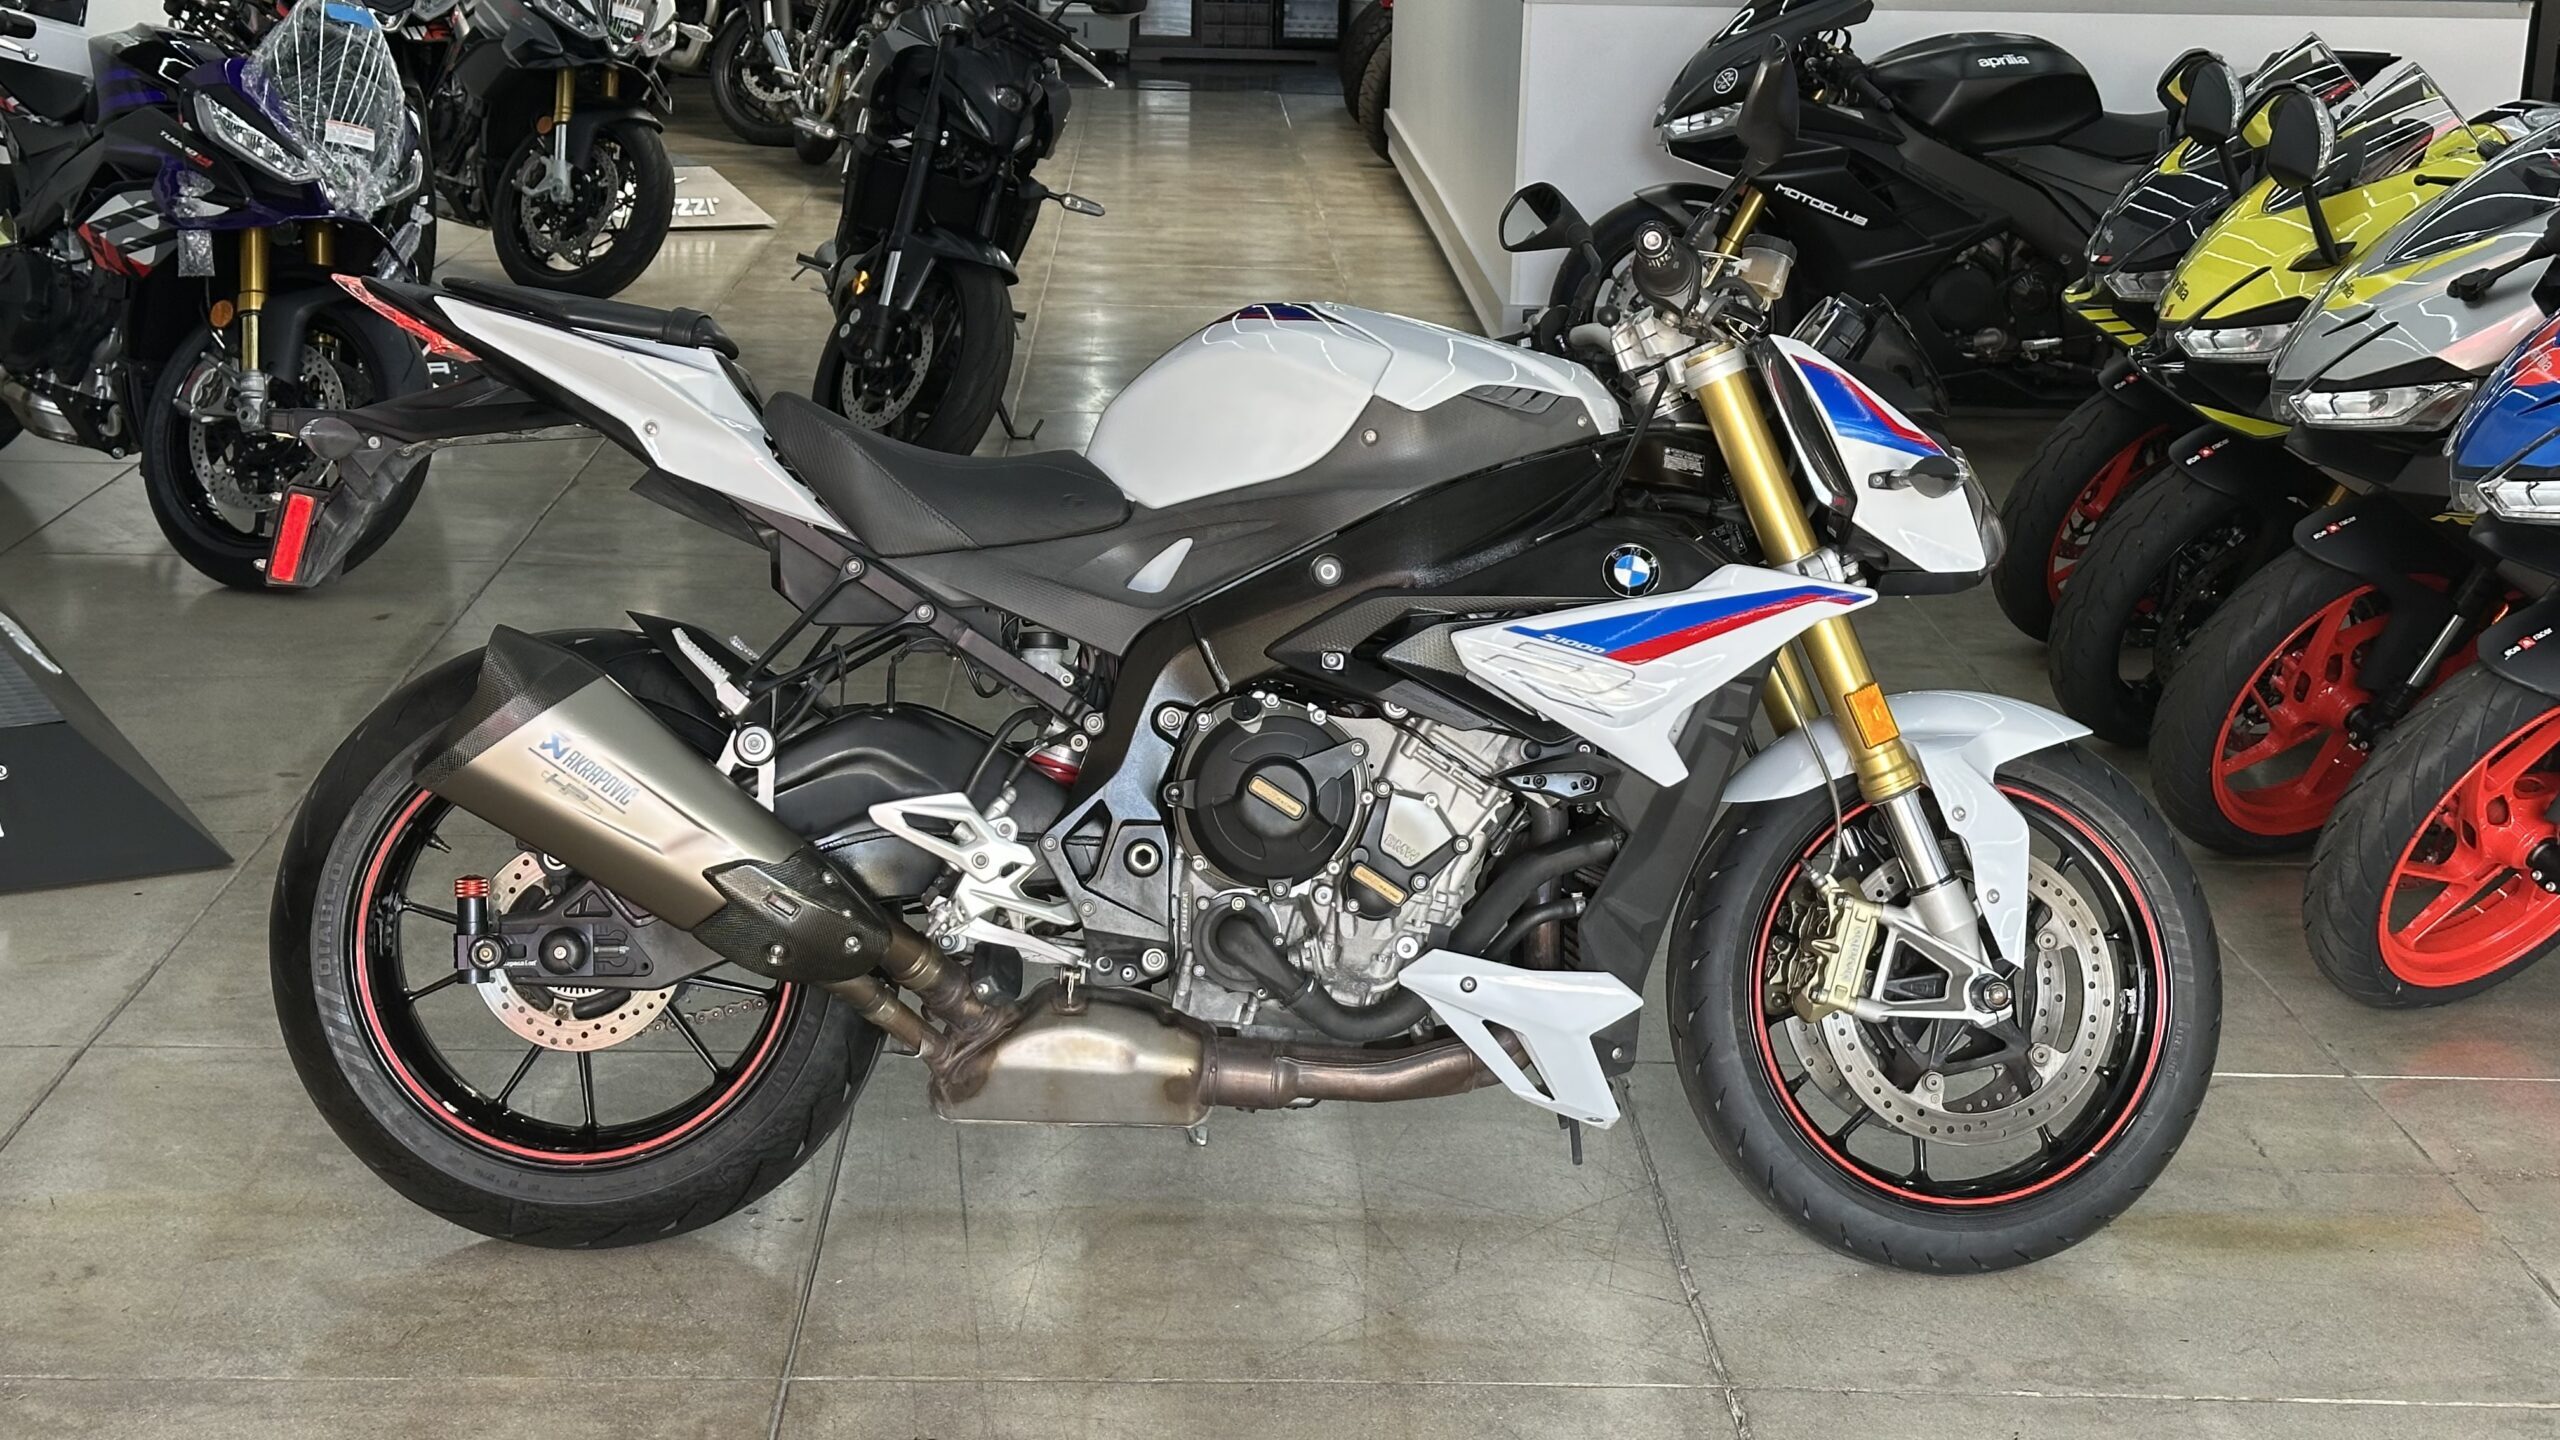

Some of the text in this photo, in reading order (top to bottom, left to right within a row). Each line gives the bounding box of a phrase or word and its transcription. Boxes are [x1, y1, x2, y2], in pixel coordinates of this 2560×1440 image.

[1977, 54, 2031, 68] aprilia
[1774, 183, 1868, 226] MOTOCLUB
[1540, 633, 1605, 654] S1000
[1384, 833, 1421, 862] BMW
[317, 861, 346, 977] DIABLO
